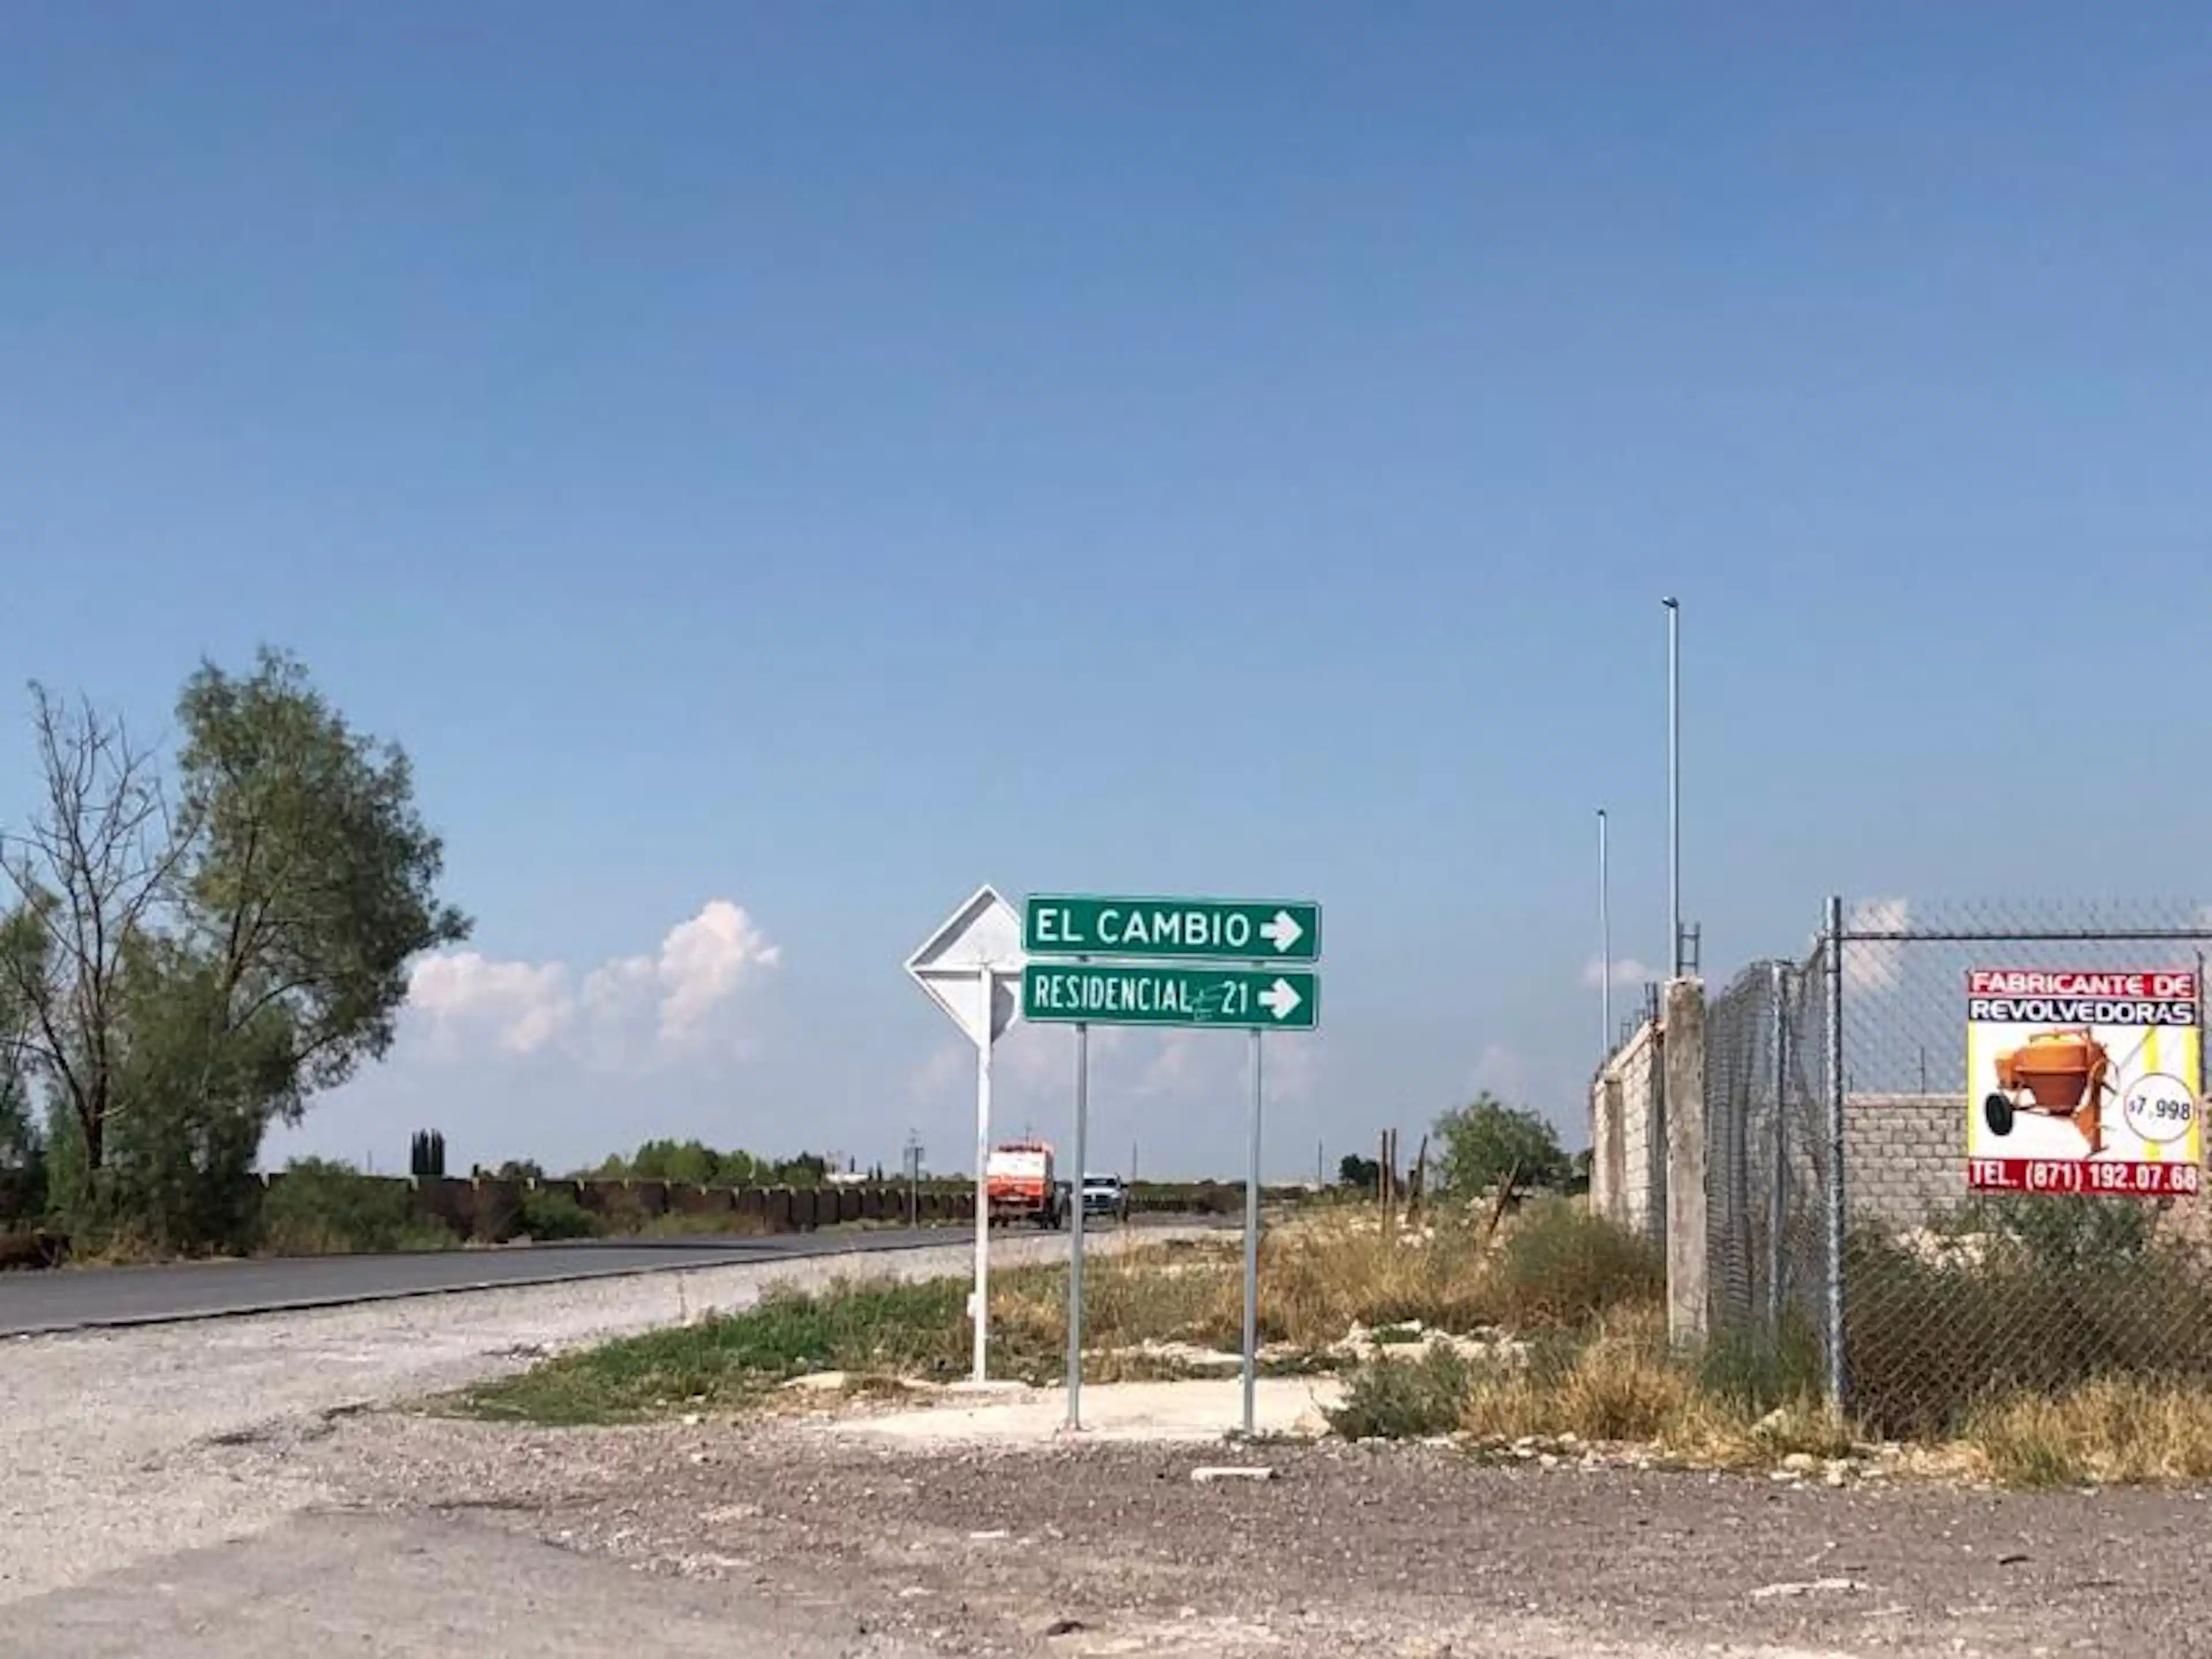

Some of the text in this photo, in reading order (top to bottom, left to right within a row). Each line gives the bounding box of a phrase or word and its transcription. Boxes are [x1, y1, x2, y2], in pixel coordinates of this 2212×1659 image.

[1037, 908, 1250, 947] EL CAMBIO
[1035, 975, 1248, 1015] RESIDENCIAL 21
[1972, 972, 2191, 998] FABRICANTE DE
[1971, 999, 2192, 1024] REVOLVEDORAS
[1971, 1160, 2018, 1186] TEL.
[2025, 1162, 2083, 1191] (871)
